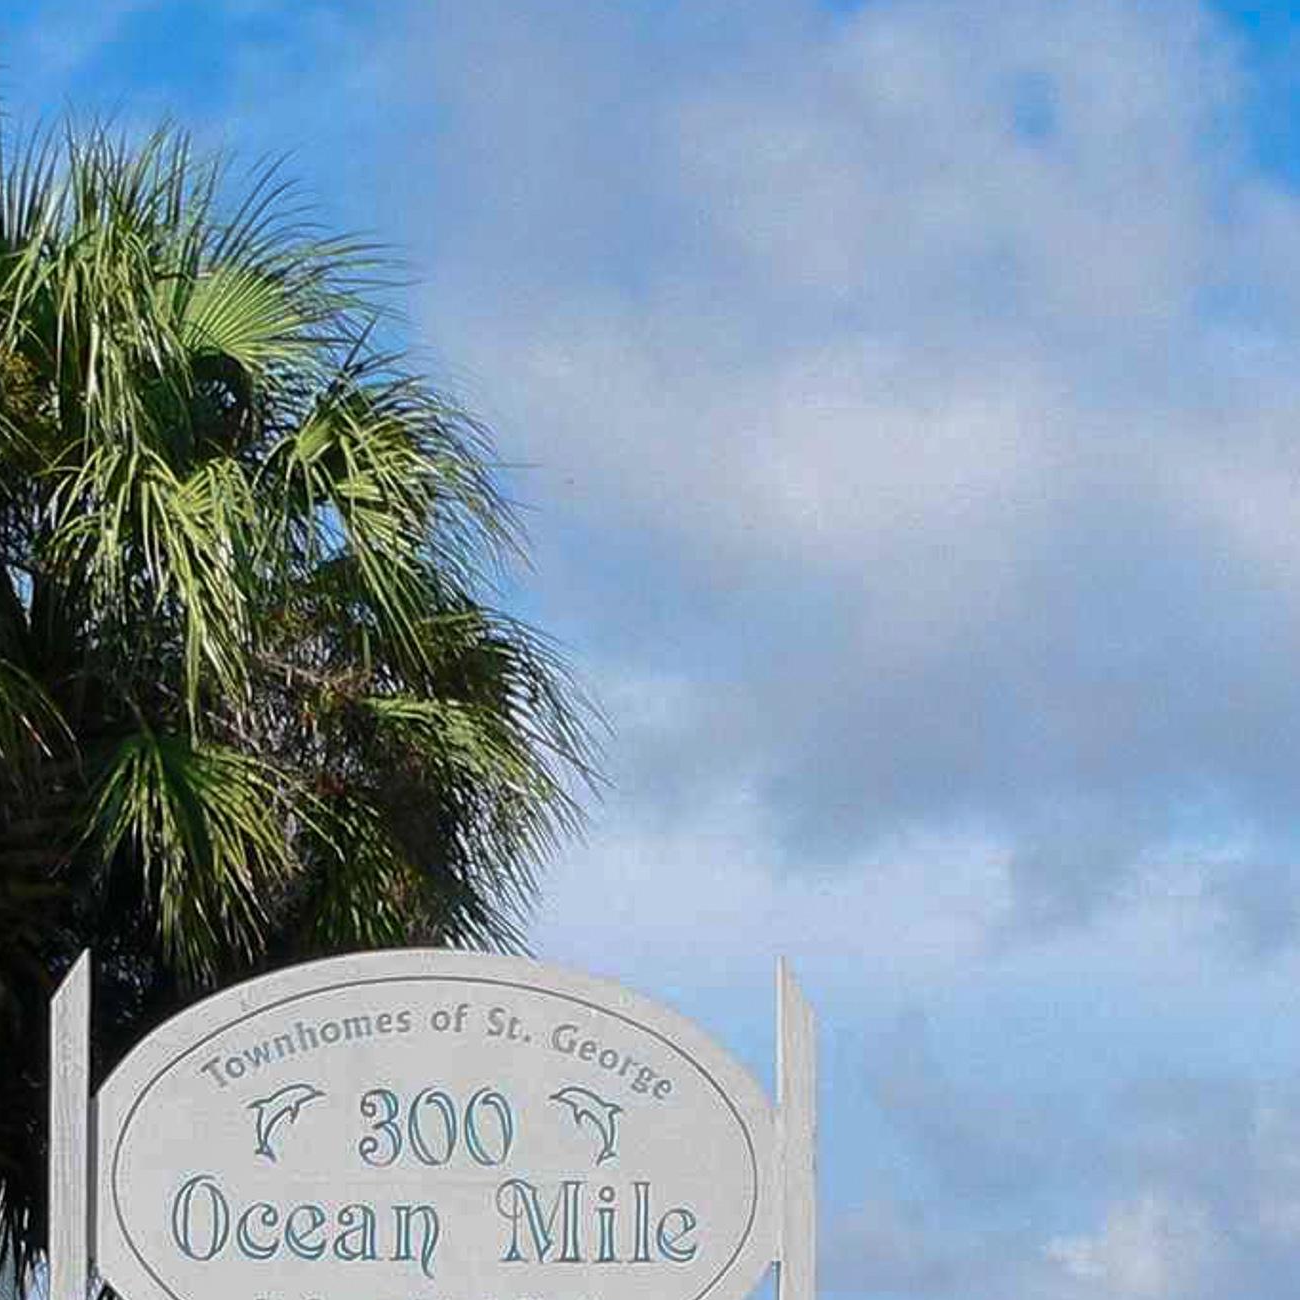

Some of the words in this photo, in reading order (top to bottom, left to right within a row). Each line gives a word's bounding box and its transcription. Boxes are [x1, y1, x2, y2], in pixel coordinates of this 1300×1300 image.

[201, 1004, 411, 1089] Townhomes
[431, 1003, 469, 1034] of
[487, 1006, 532, 1043] St.
[551, 1022, 674, 1101] George
[359, 1087, 514, 1167] 300
[172, 1174, 440, 1279] Ocean
[495, 1178, 699, 1264] Mile
